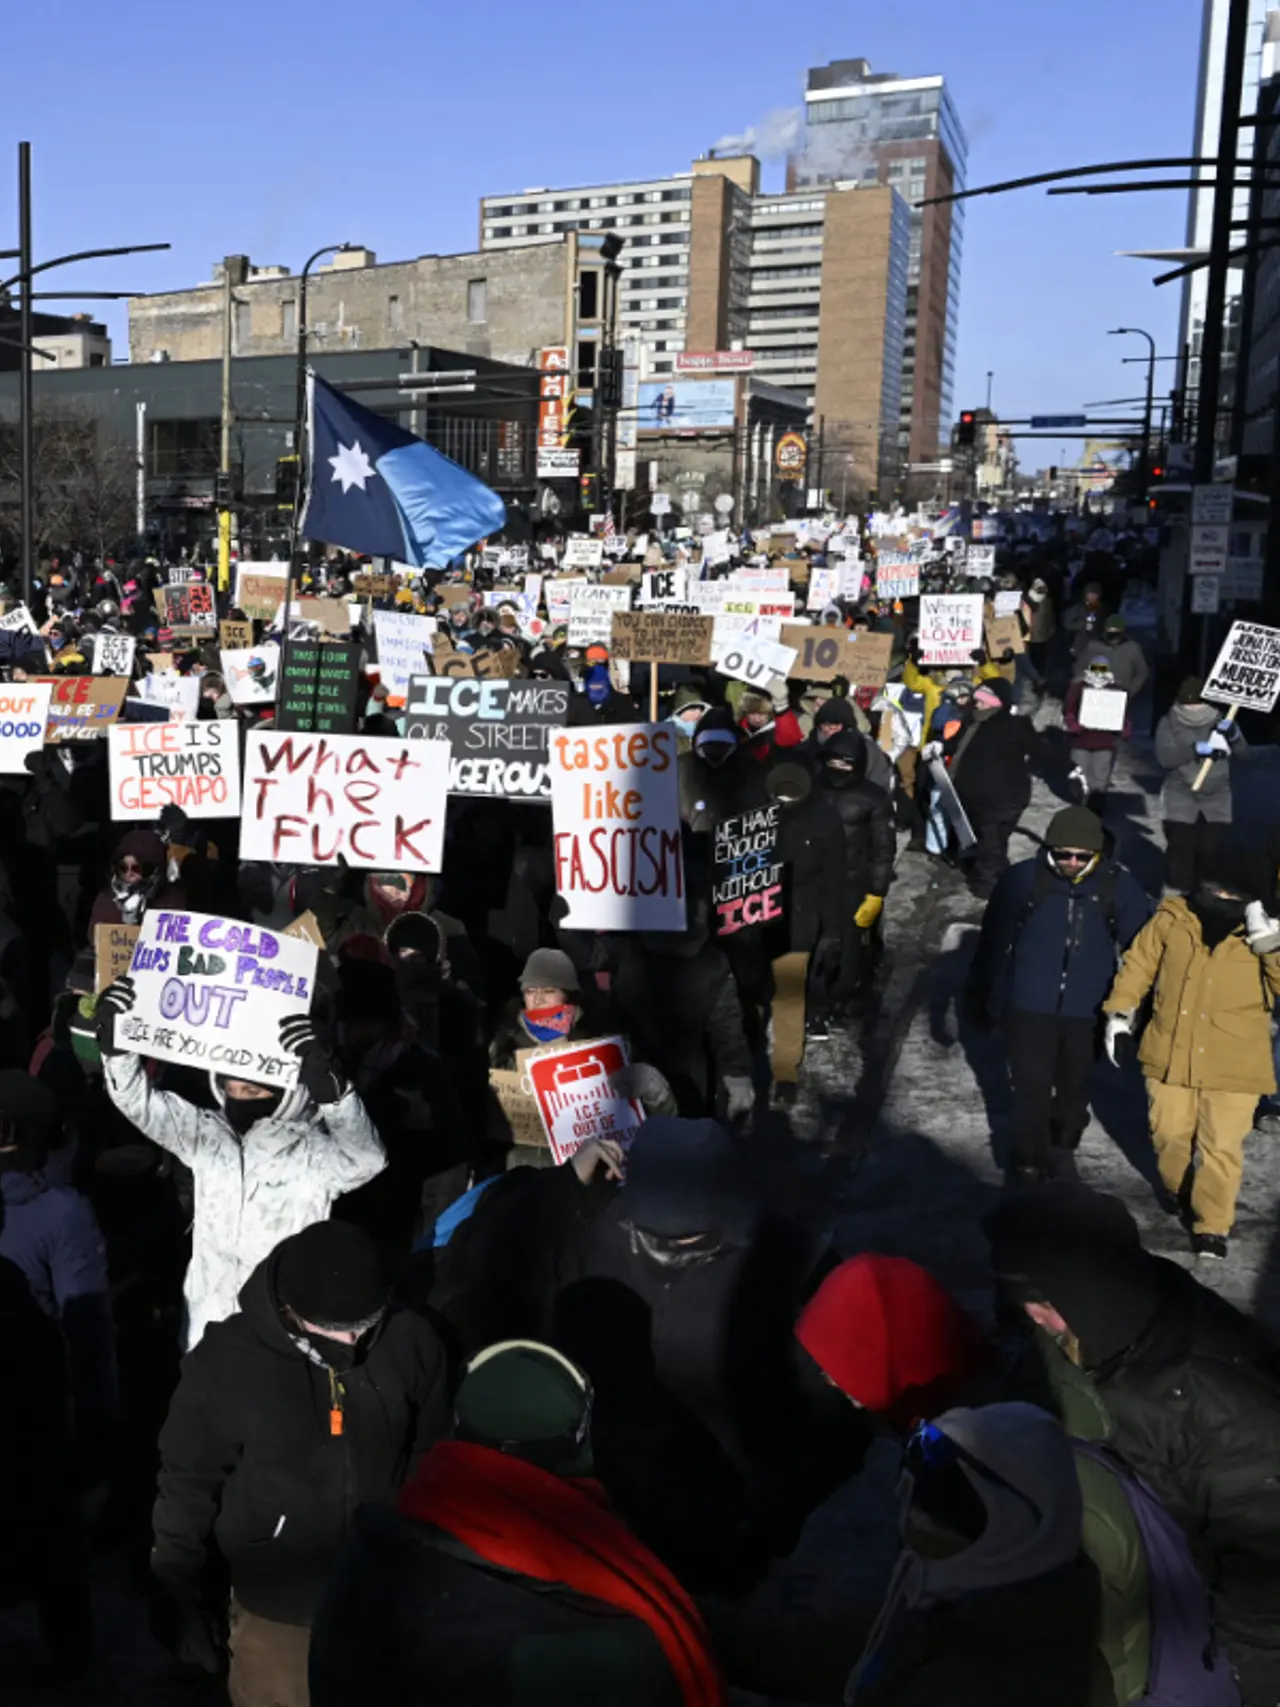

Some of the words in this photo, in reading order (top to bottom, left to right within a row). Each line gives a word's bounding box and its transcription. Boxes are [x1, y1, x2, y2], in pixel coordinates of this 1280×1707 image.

[651, 571, 676, 599] ICE
[103, 637, 129, 648] ICE
[922, 629, 974, 642] LOVE
[102, 649, 128, 661] OUT
[724, 652, 786, 686] OUT
[803, 638, 838, 669] 10
[1210, 679, 1277, 701] NOW!
[1219, 661, 1279, 688] MURDER
[409, 675, 510, 720] ICE
[507, 689, 568, 714] MAKES
[118, 723, 181, 756] ICE
[185, 722, 222, 747] IS
[554, 731, 670, 772] tastes
[258, 736, 422, 780] What
[119, 776, 228, 810] GESTAPO
[582, 780, 643, 821] like
[271, 813, 433, 865] FUCK
[714, 818, 738, 843] WE
[740, 804, 781, 832] HAVE
[553, 826, 683, 899] FASCISM
[714, 830, 778, 864] ENOUGH
[726, 849, 772, 878] ICE
[712, 862, 785, 904] WITHOUT
[716, 884, 783, 937] ICE
[155, 912, 191, 943] THE
[198, 918, 280, 959] COLD
[176, 945, 227, 976] BAD
[158, 976, 248, 1029] OUT
[151, 1026, 177, 1050] ARE
[177, 1032, 208, 1058] YOU
[209, 1044, 252, 1066] COLD
[256, 1052, 300, 1086] YET?
[572, 1119, 598, 1138] OUT
[599, 1114, 616, 1130] OF
